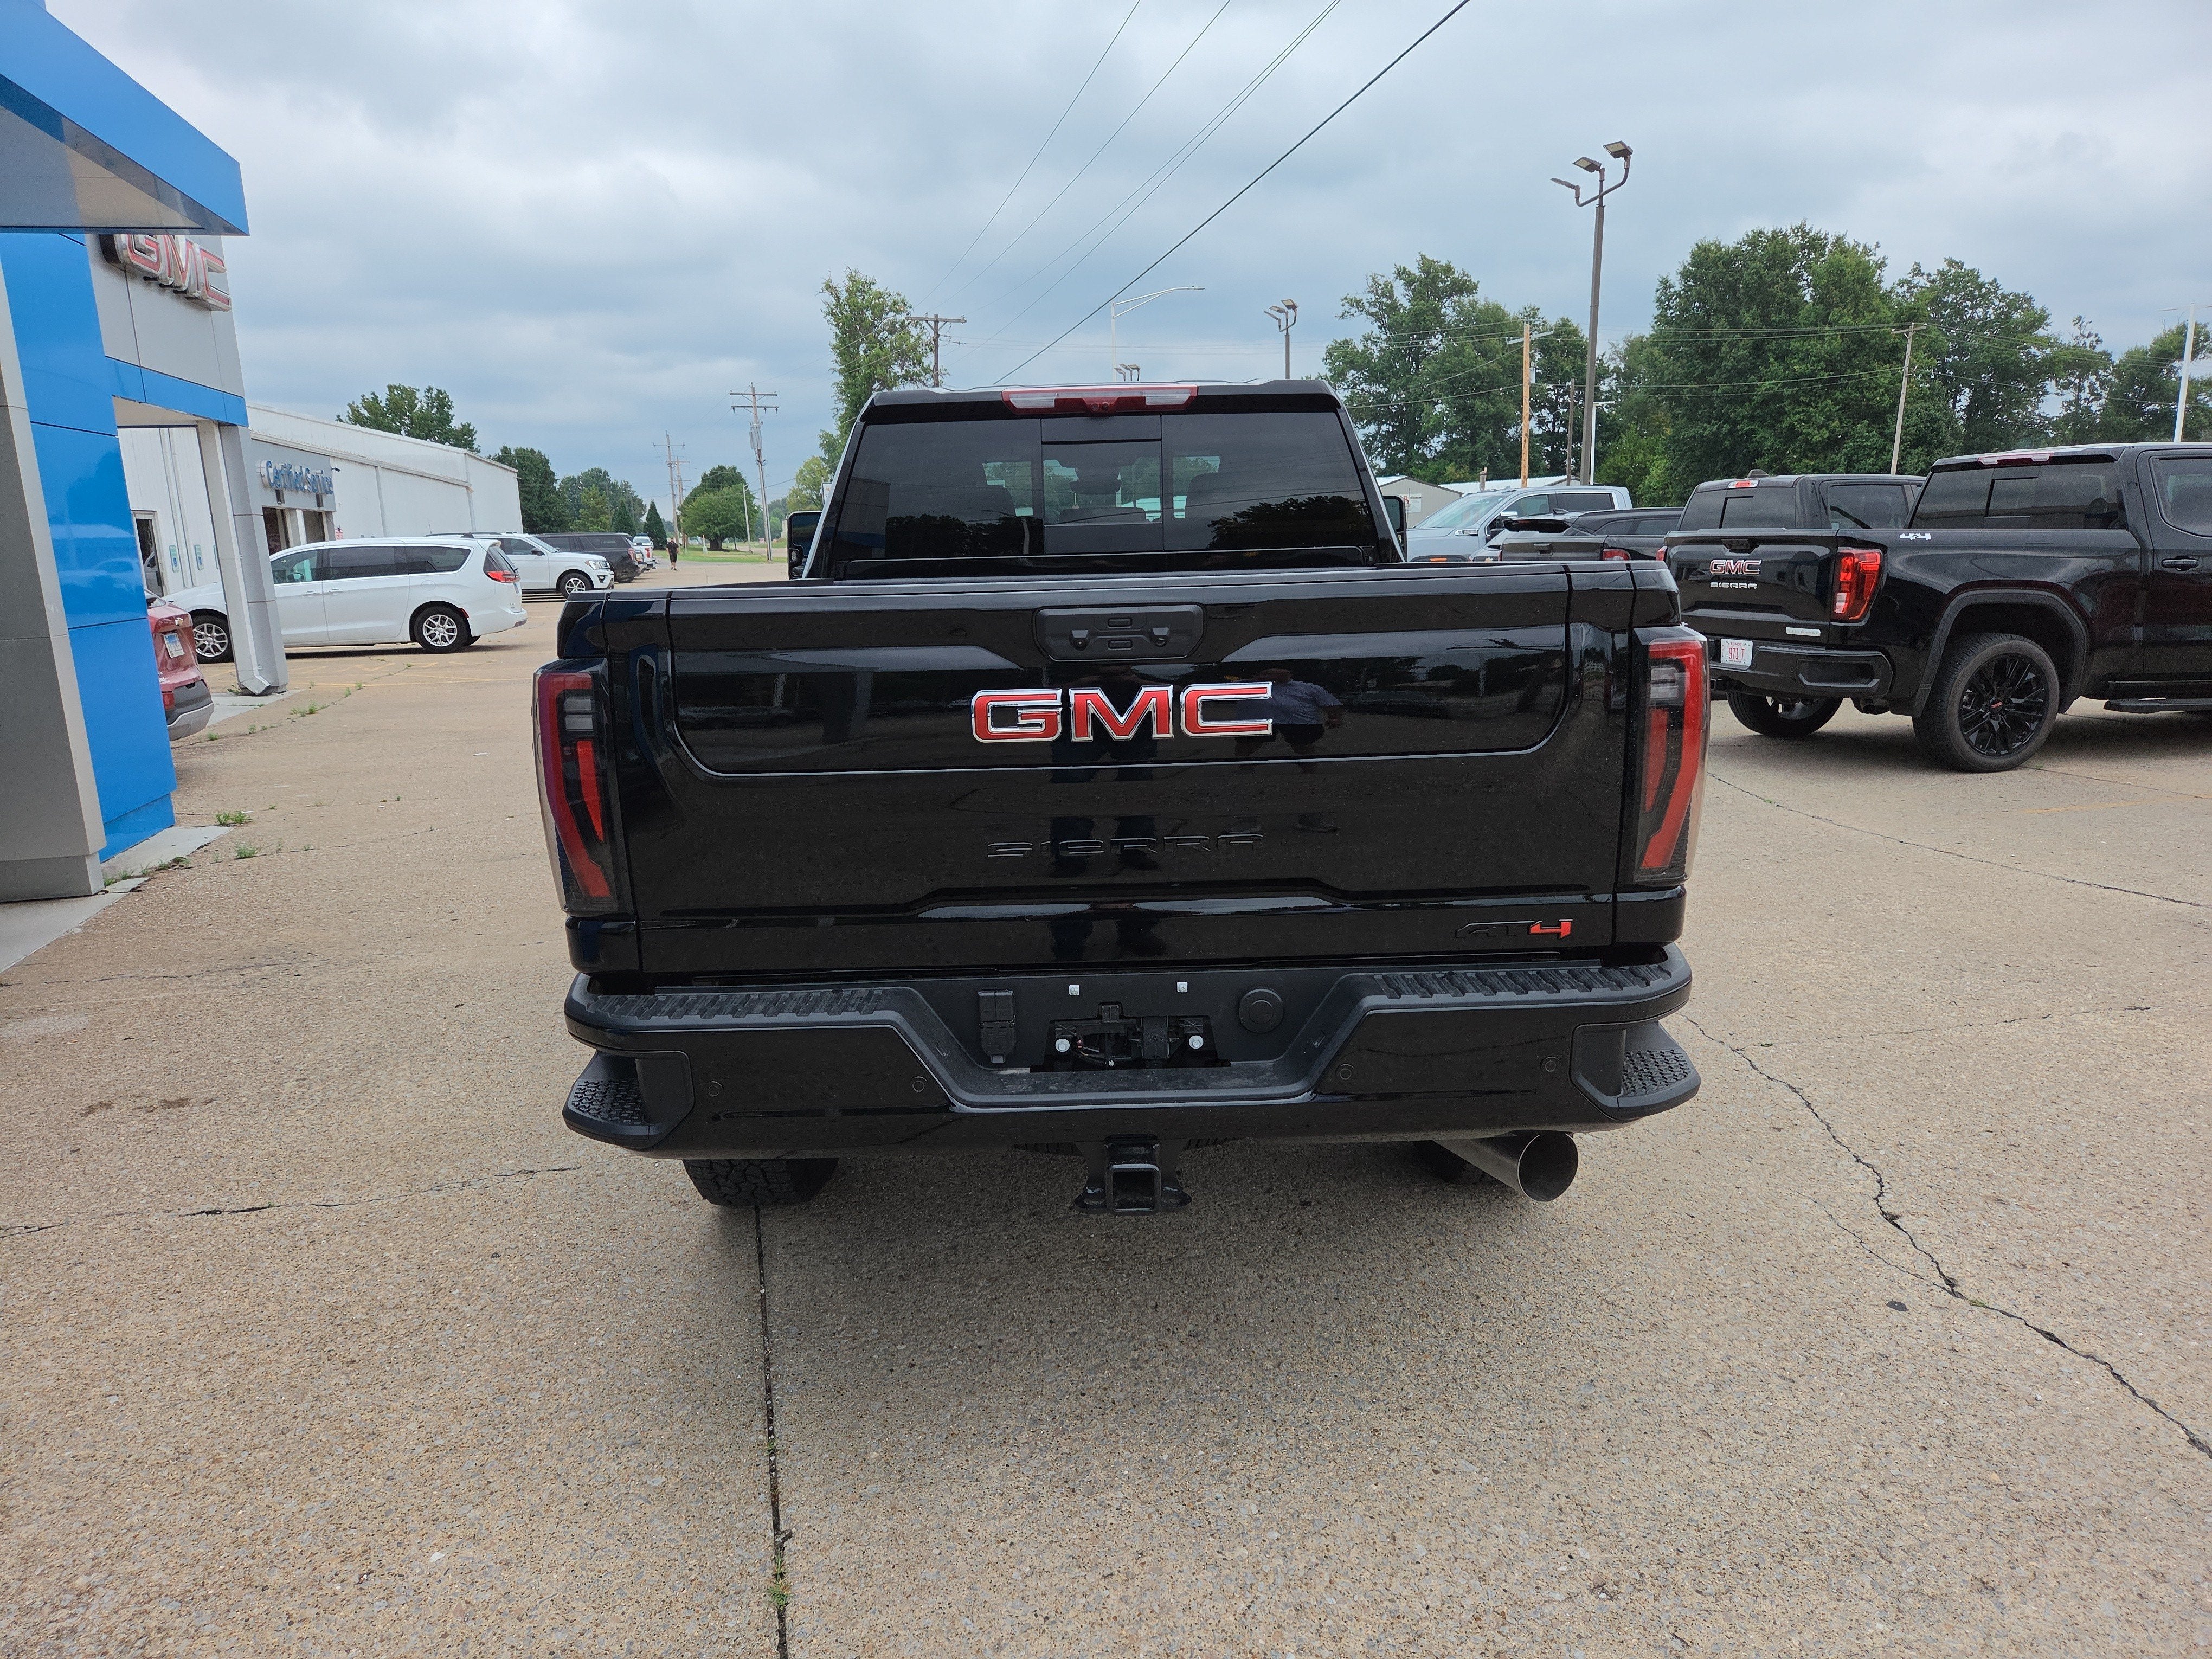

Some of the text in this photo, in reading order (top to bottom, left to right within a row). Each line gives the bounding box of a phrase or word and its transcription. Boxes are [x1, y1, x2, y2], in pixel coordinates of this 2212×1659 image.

[113, 234, 232, 312] GMC
[1709, 559, 1762, 575] GMC
[971, 681, 1272, 743] GMC
[987, 834, 1264, 857] SIERRA
[1455, 919, 1573, 938] AT4
